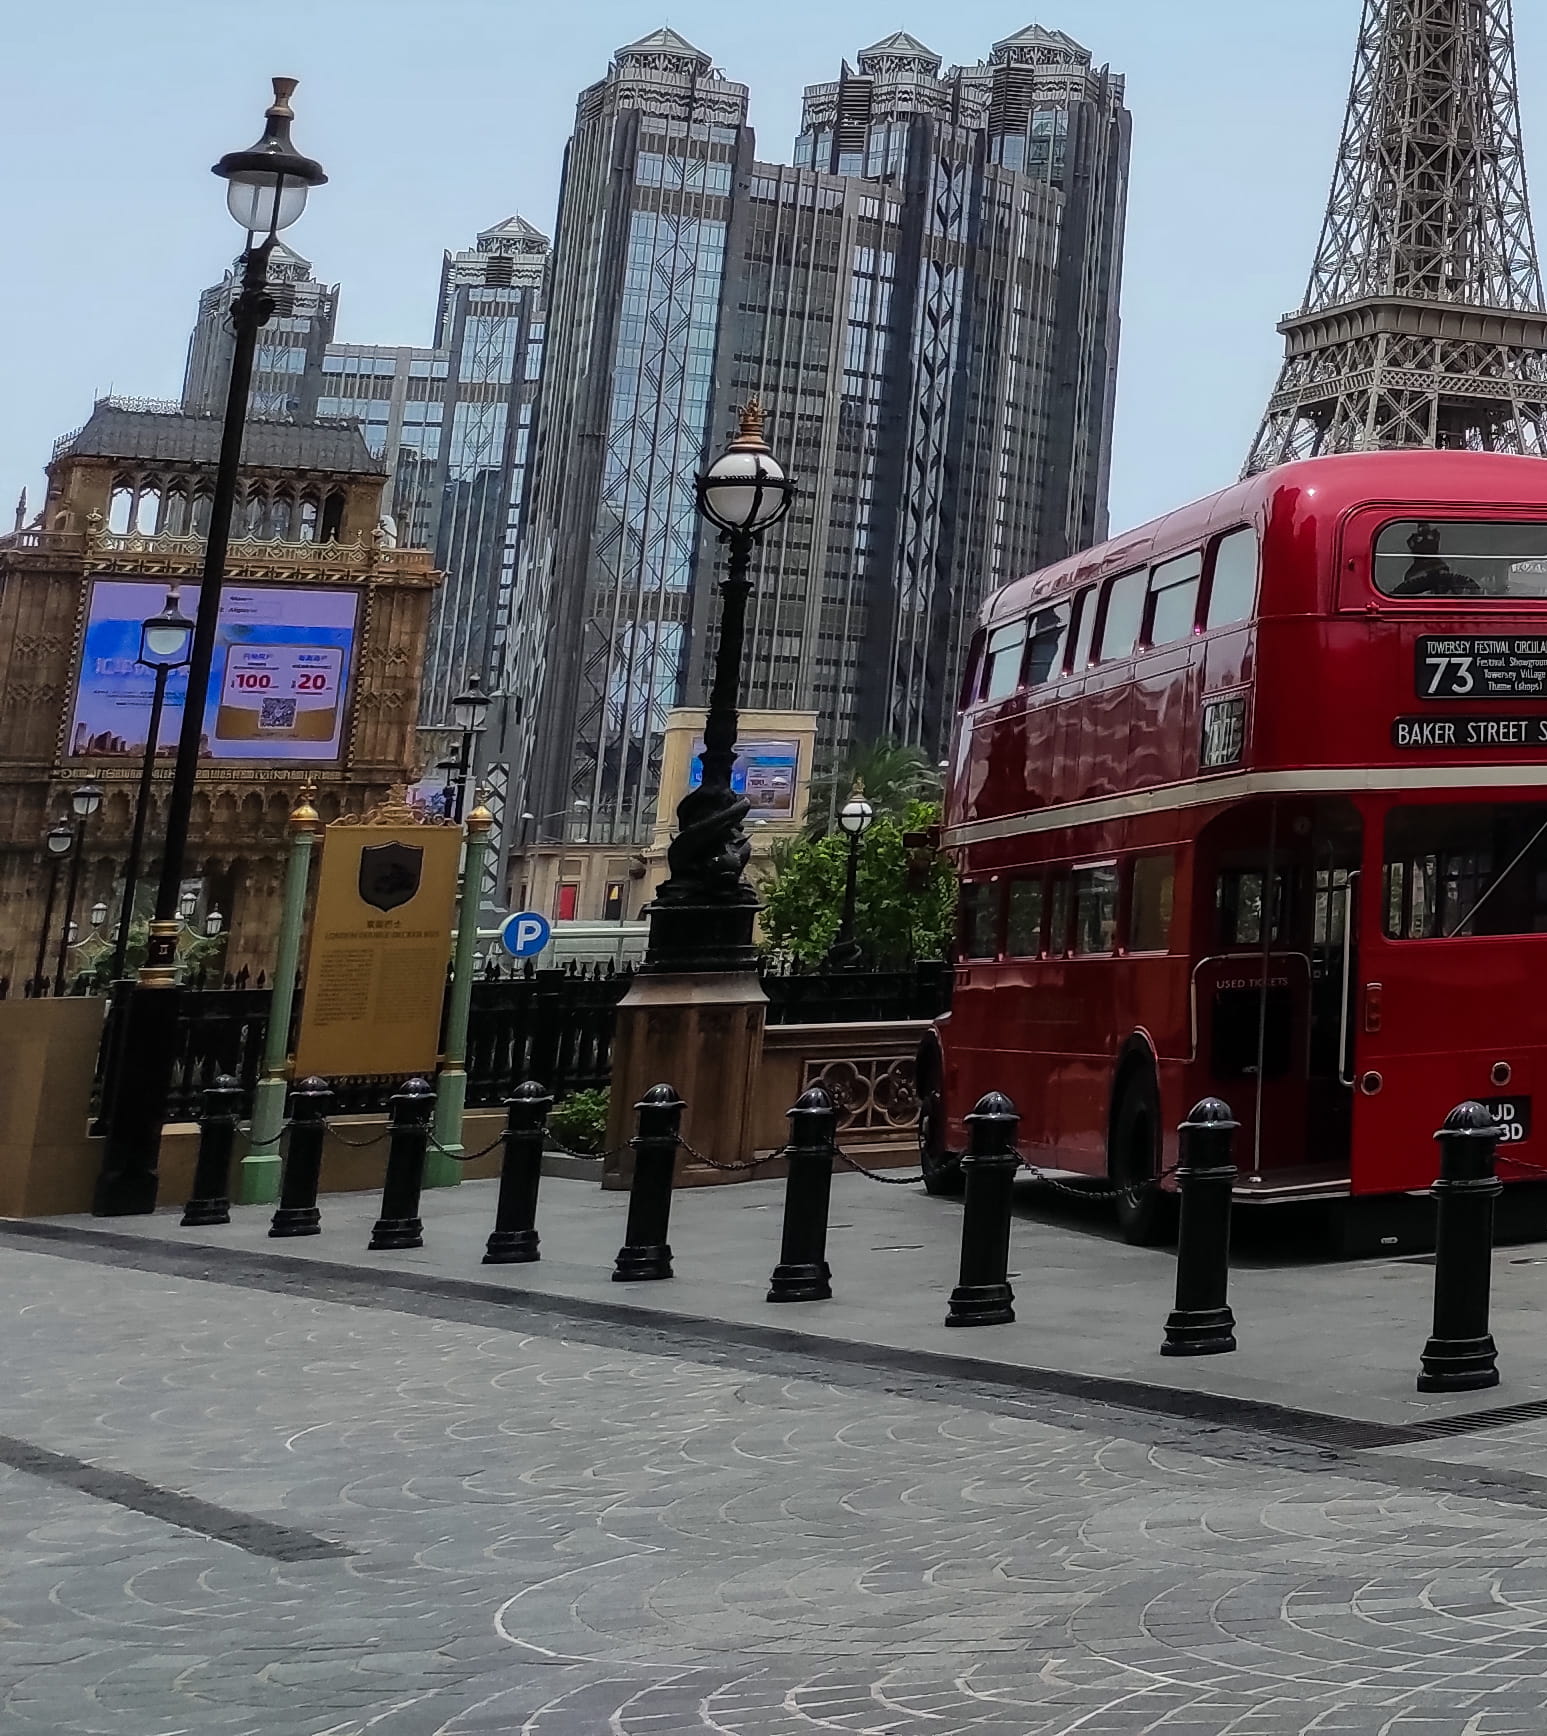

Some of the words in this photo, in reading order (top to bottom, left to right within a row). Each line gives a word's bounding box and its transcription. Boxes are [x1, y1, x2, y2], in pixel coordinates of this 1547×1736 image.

[1426, 640, 1471, 655] TOWERSEY
[1474, 640, 1511, 654] FESTIVAL
[236, 673, 271, 689] 100
[298, 673, 326, 690] 20
[1425, 657, 1474, 694] 73
[1520, 669, 1546, 680] Village
[1398, 722, 1456, 745] BAKER
[1466, 721, 1529, 743] STREET
[516, 919, 543, 952] P
[1216, 978, 1246, 989] USED
[1486, 1103, 1515, 1122] JD
